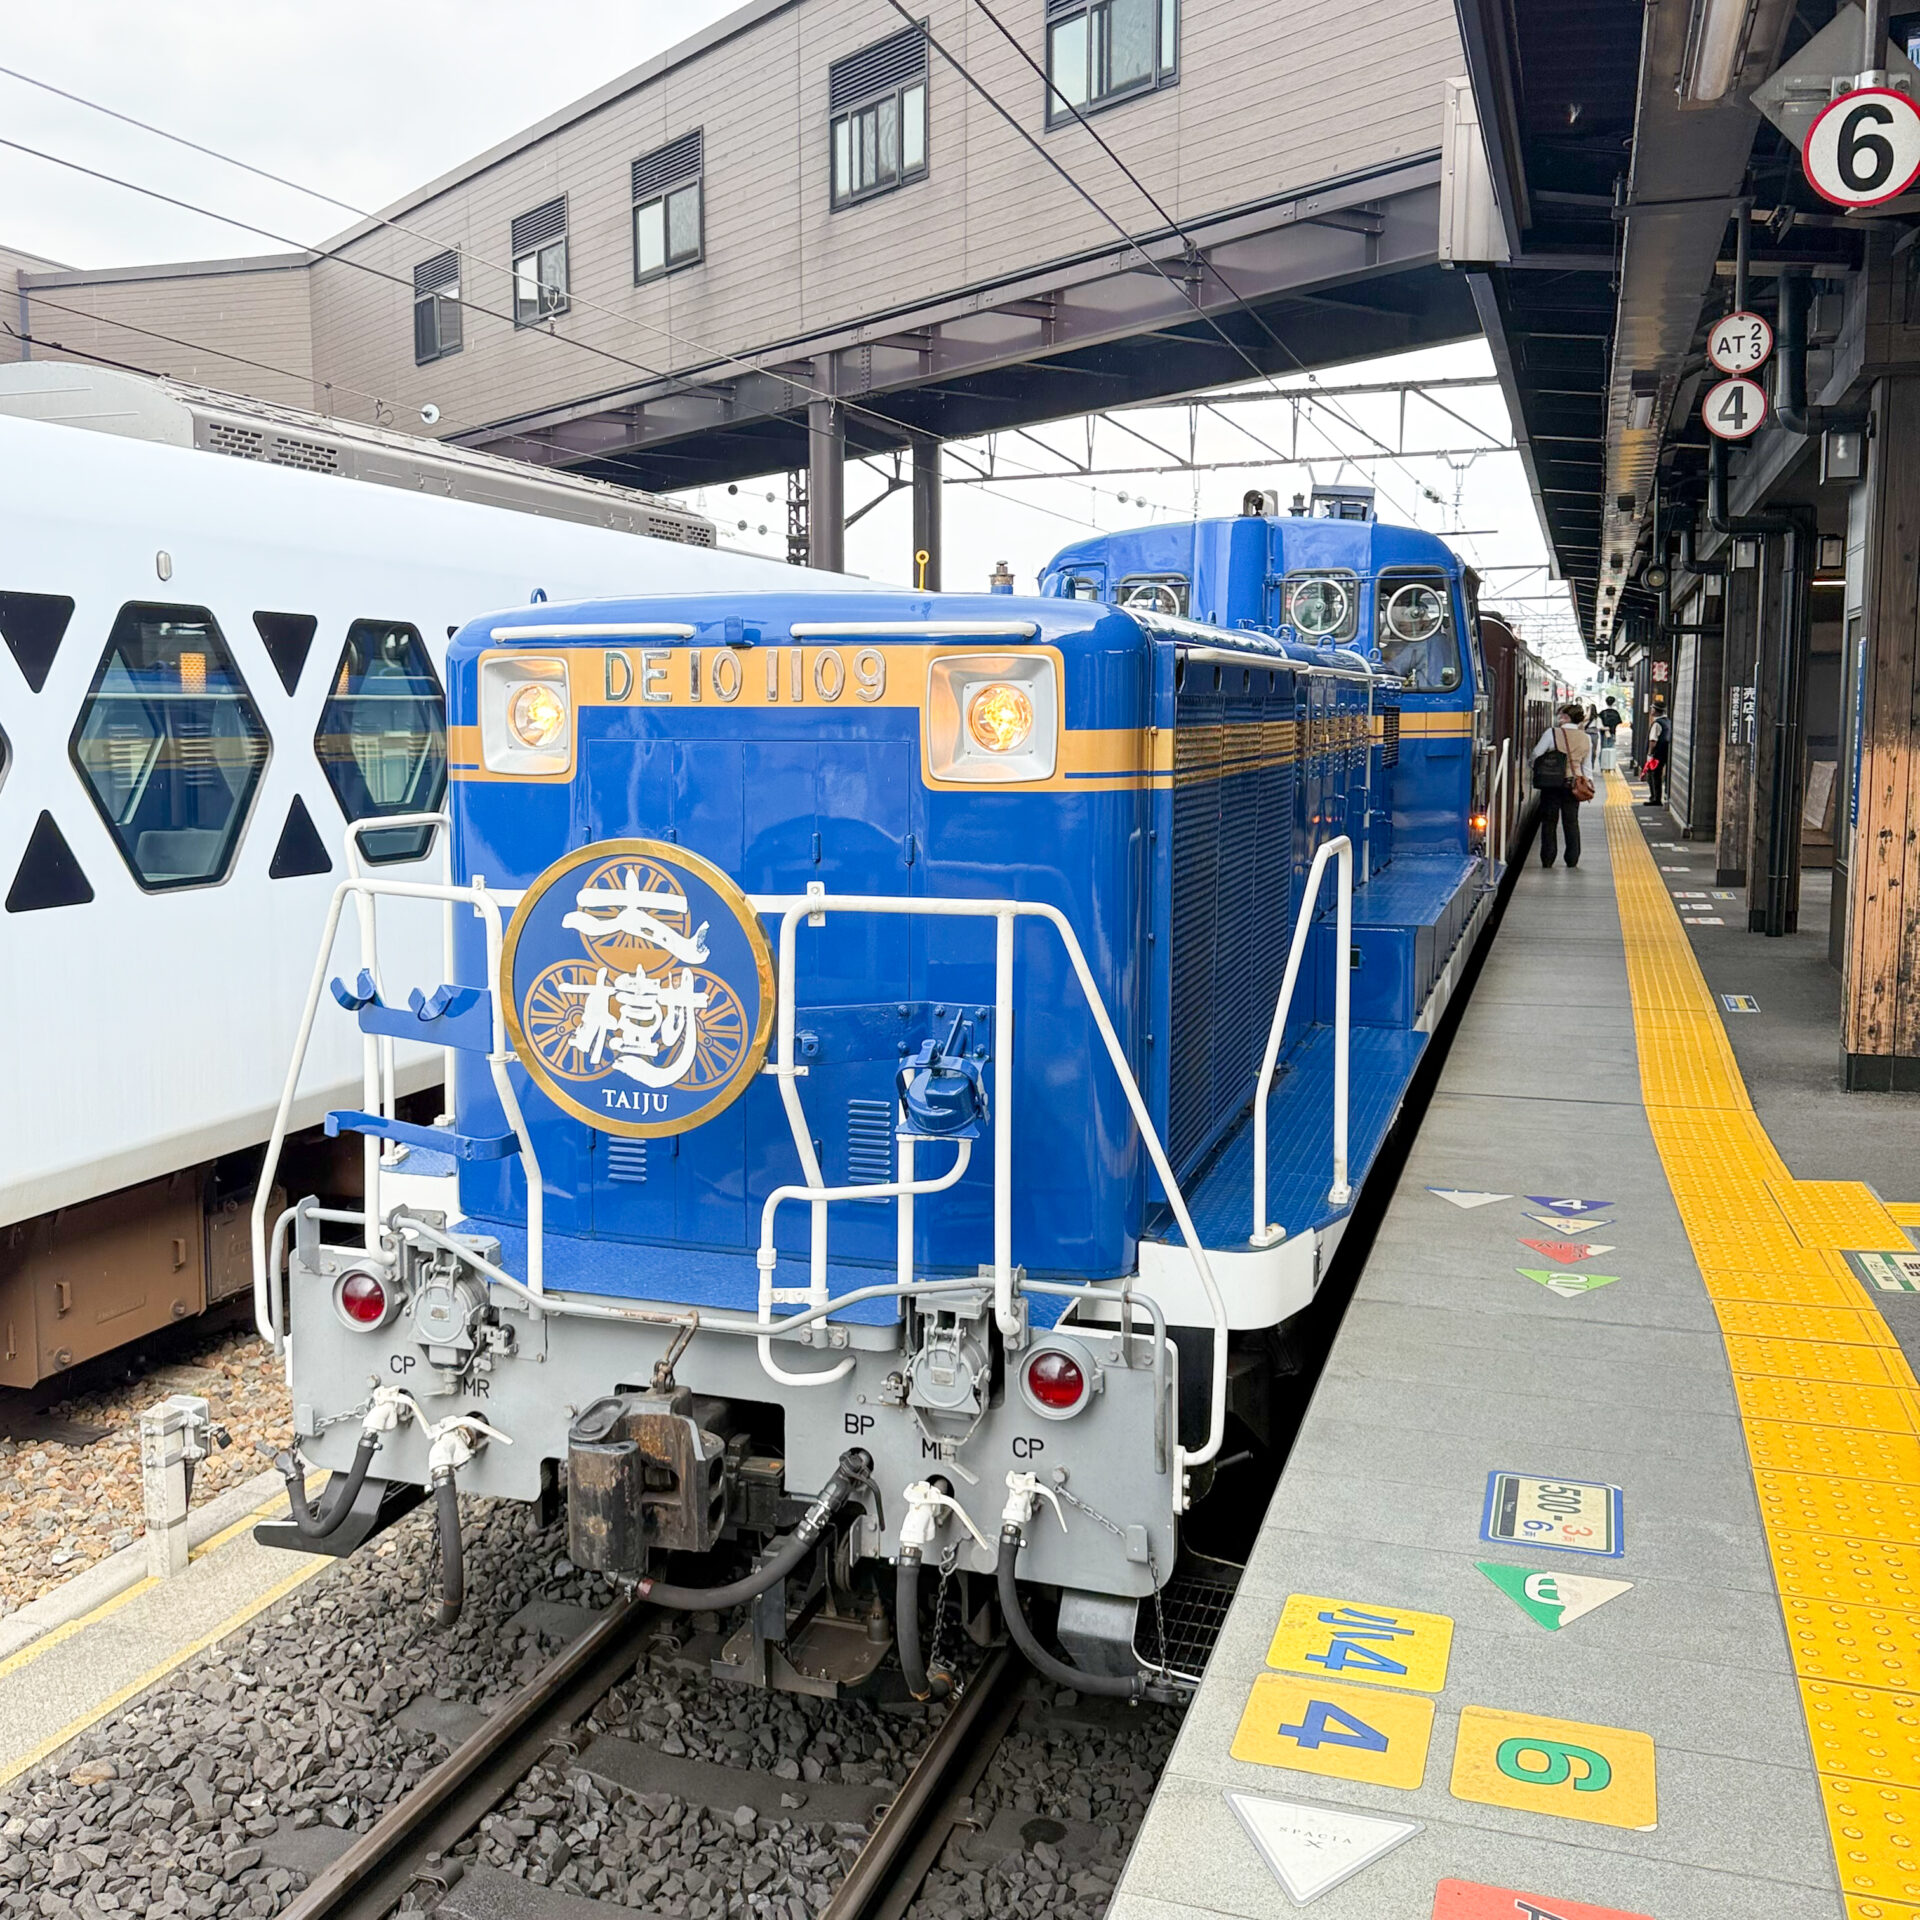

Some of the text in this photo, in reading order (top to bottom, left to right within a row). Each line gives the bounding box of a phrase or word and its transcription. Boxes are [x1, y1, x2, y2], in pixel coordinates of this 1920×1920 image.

[1837, 102, 1895, 192] 6
[1750, 322, 1762, 340] 2
[1716, 334, 1746, 356] AT
[1749, 341, 1762, 360] 3
[1717, 386, 1748, 430] 4
[1743, 687, 1756, 713] 売店
[561, 869, 711, 1088] 大樹
[602, 1088, 669, 1114] TAIJU
[390, 1354, 416, 1375] CP
[463, 1377, 490, 1399] MR
[844, 1413, 875, 1435] BP
[1012, 1436, 1044, 1459] CP
[1304, 1607, 1415, 1676] 小4
[1277, 1700, 1390, 1752] 4
[1495, 1737, 1612, 1792] 6
[1279, 1826, 1352, 1845] SPACIA
